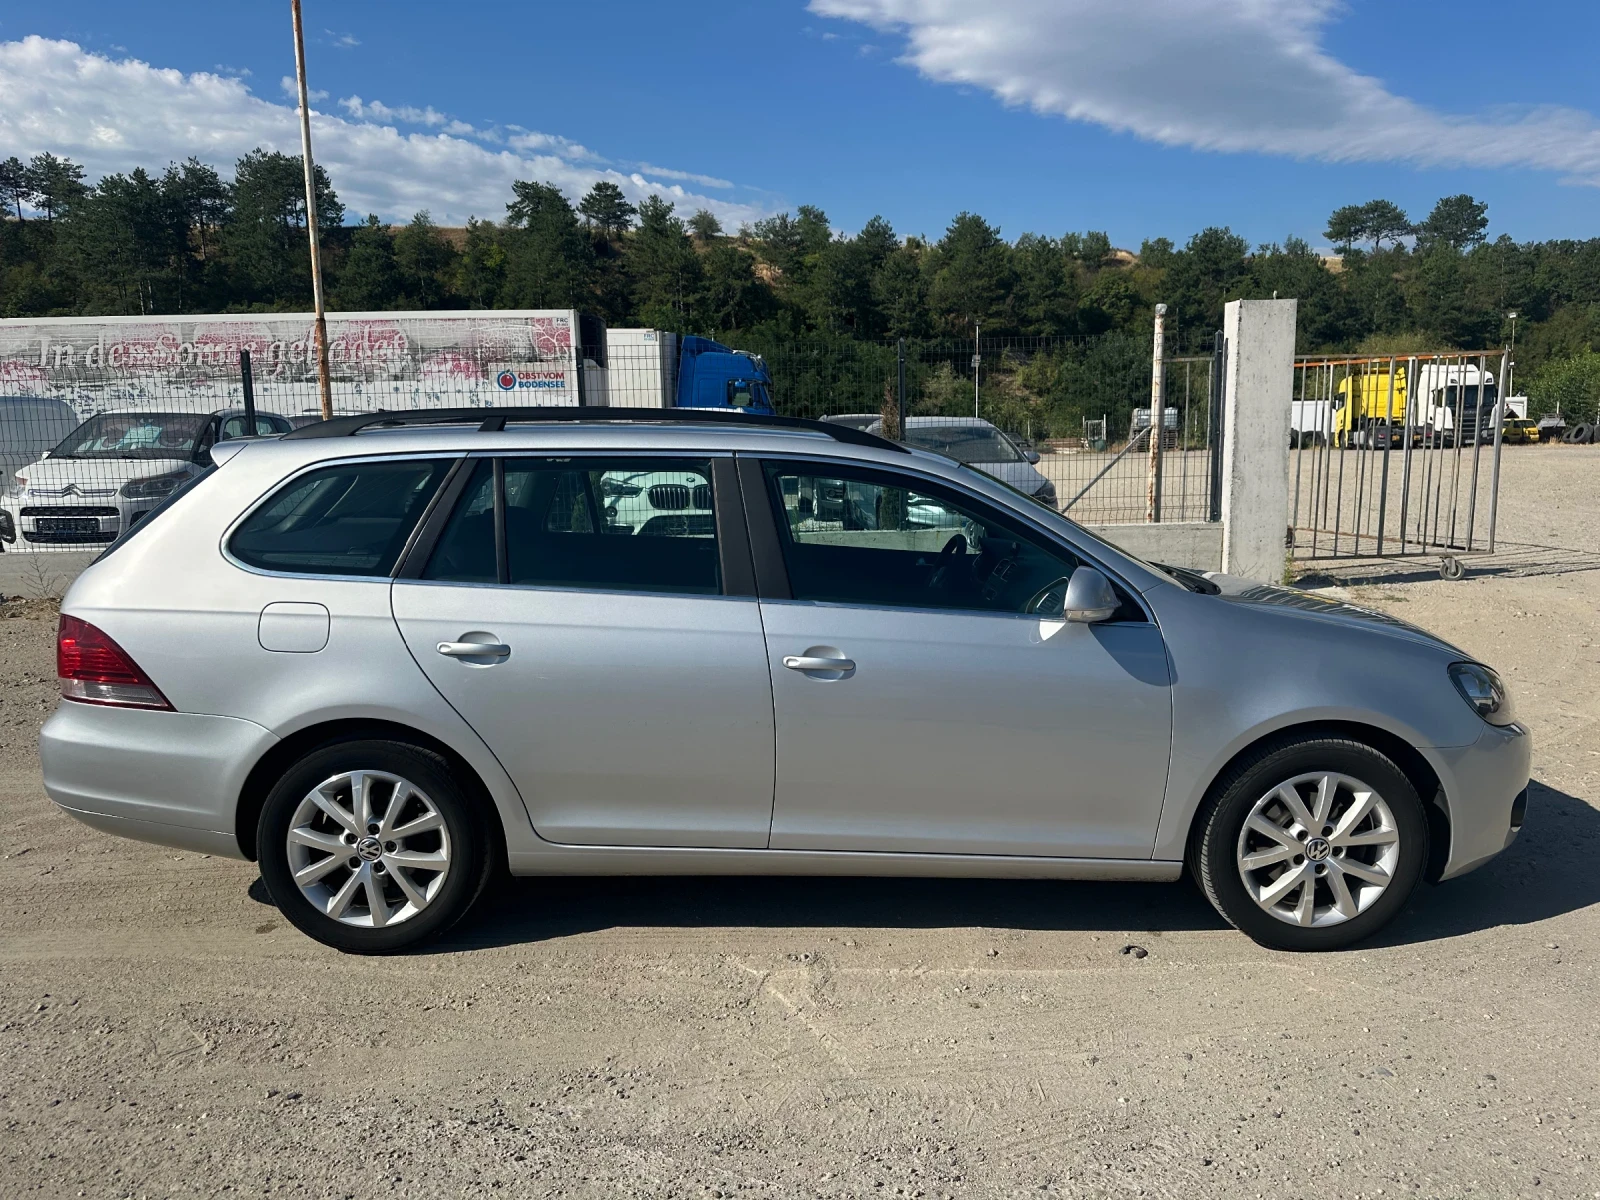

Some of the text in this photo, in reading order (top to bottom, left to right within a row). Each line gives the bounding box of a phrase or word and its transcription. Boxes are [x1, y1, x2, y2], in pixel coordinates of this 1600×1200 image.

[36, 334, 75, 367] In
[518, 372, 565, 380] OBST VOM
